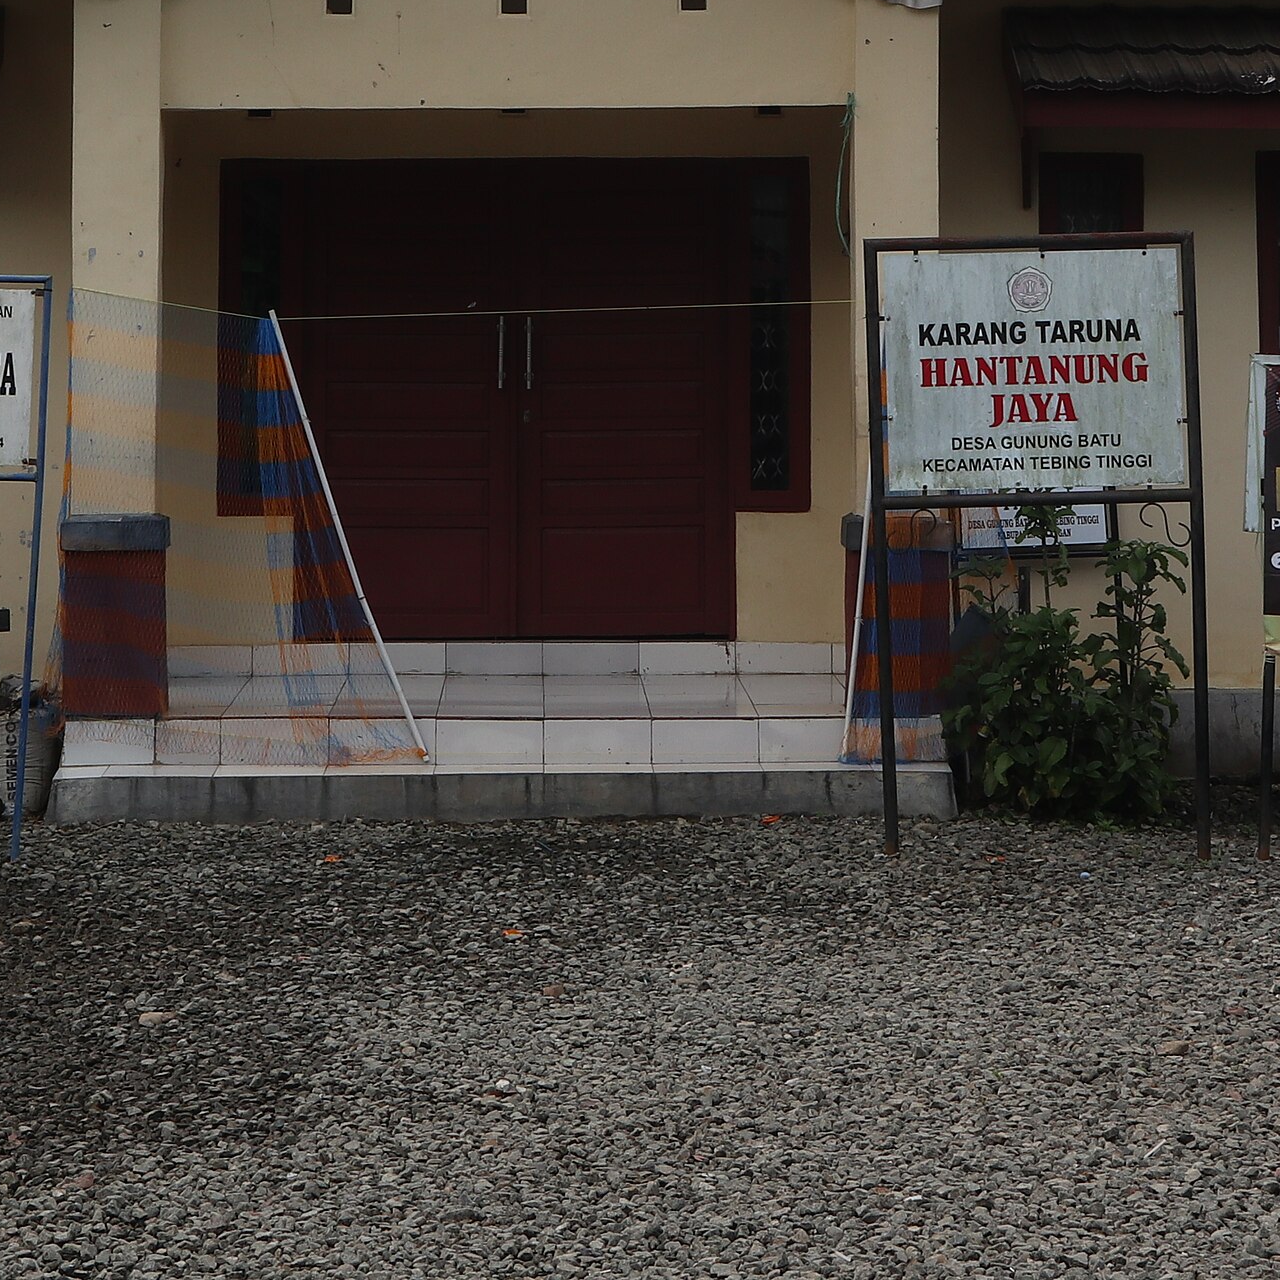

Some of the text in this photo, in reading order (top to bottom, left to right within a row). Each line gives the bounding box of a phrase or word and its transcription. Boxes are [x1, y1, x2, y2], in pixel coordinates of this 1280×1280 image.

[919, 319, 1141, 346] KARANG TARUNA
[920, 353, 1149, 388] HANTANUNG
[989, 393, 1079, 428] JAYA
[951, 433, 1122, 451] DESA GUNUNG BATU
[922, 454, 1153, 472] KECAMATAN TEBING TINGGI
[969, 520, 985, 529] DESA
[1076, 515, 1099, 525] TINGGI
